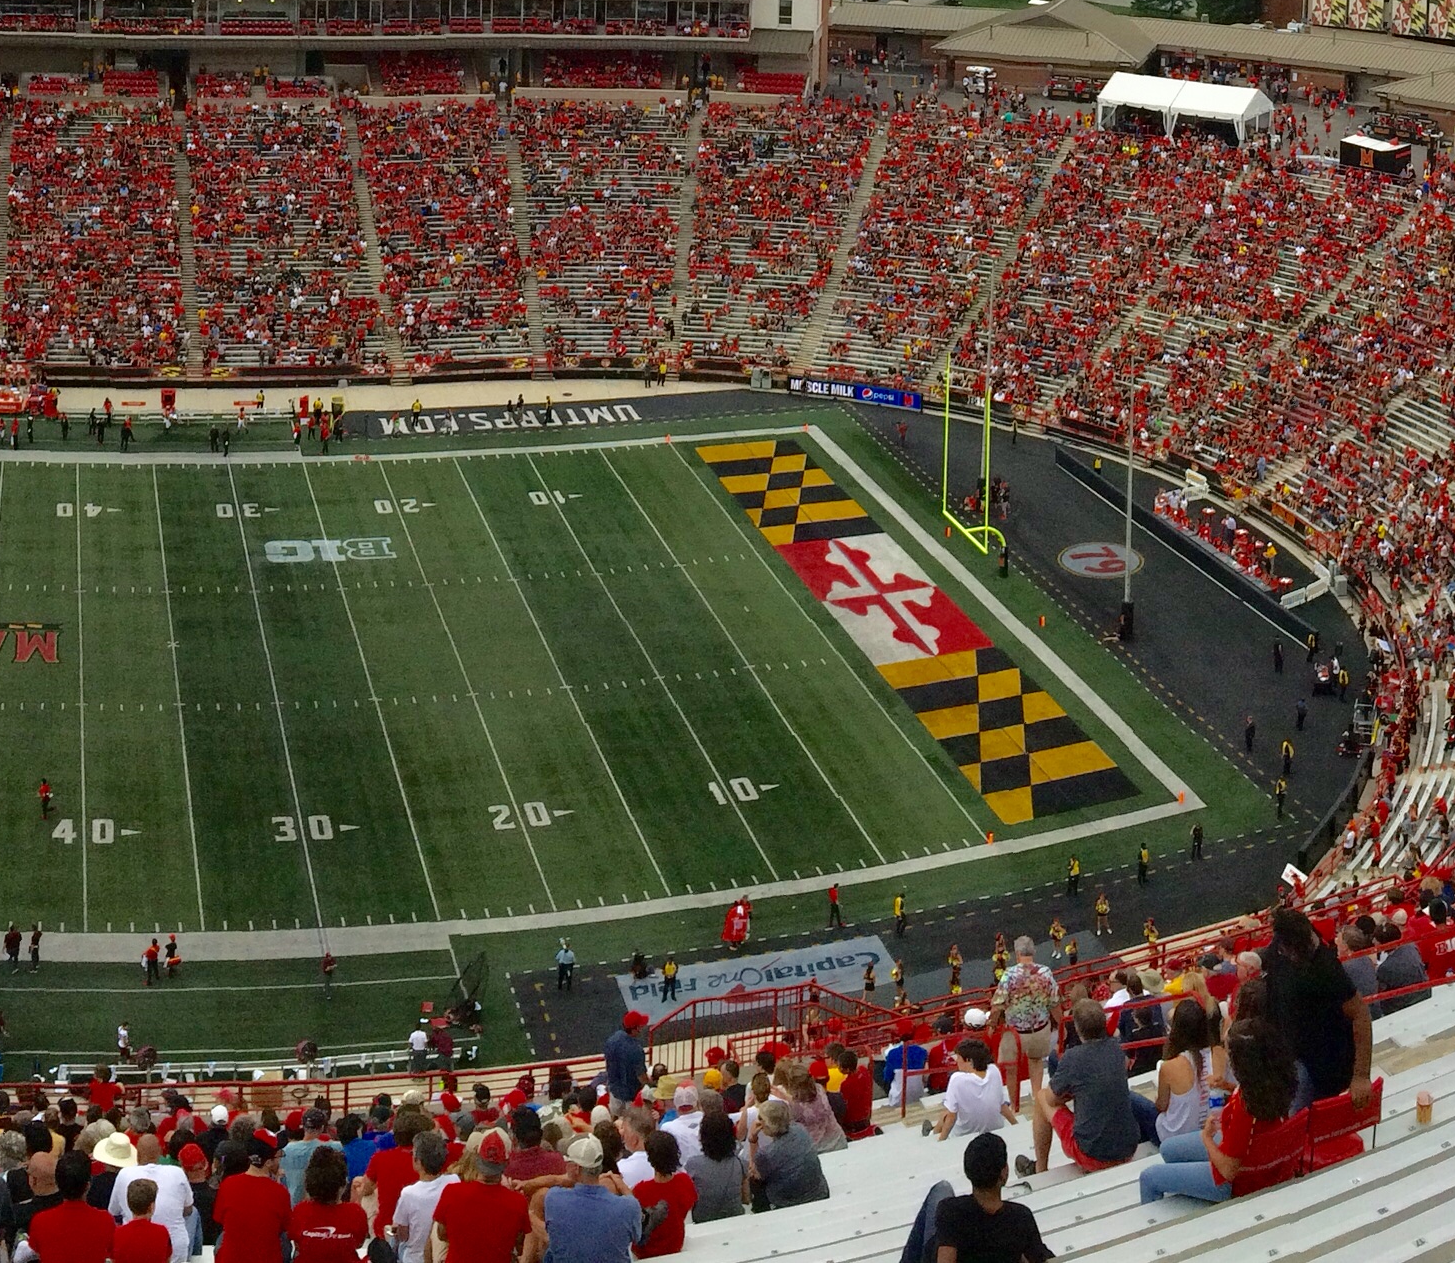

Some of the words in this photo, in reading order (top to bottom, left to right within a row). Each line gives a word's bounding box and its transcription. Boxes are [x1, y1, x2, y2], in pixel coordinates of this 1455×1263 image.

[1360, 148, 1374, 168] M
[831, 385, 854, 398] MILK
[874, 392, 894, 402] pepsi
[378, 404, 643, 436] UMTERPS.COM
[374, 497, 422, 515] 20
[528, 489, 572, 507] 10
[56, 501, 104, 518] 40
[215, 501, 262, 520] 30
[707, 776, 758, 806] 10
[488, 801, 551, 831] 20
[52, 818, 115, 845] 40
[273, 814, 334, 842] 30
[708, 967, 763, 987] One
[764, 950, 881, 984] Capital
[302, 1230, 326, 1238] Capital
